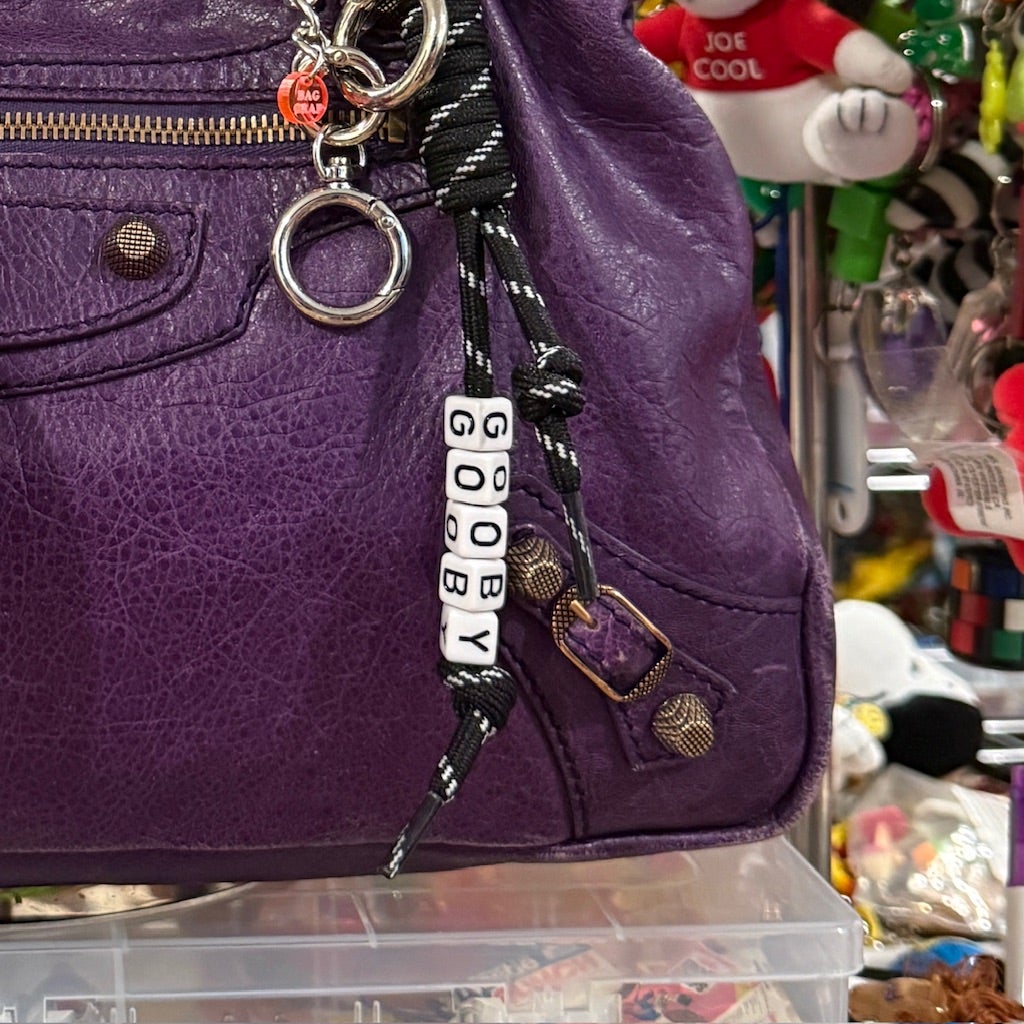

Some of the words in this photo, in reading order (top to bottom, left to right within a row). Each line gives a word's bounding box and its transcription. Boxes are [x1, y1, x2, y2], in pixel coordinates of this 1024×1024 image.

[704, 31, 748, 53] JOE
[693, 57, 764, 81] COOL
[297, 89, 321, 102] BAG
